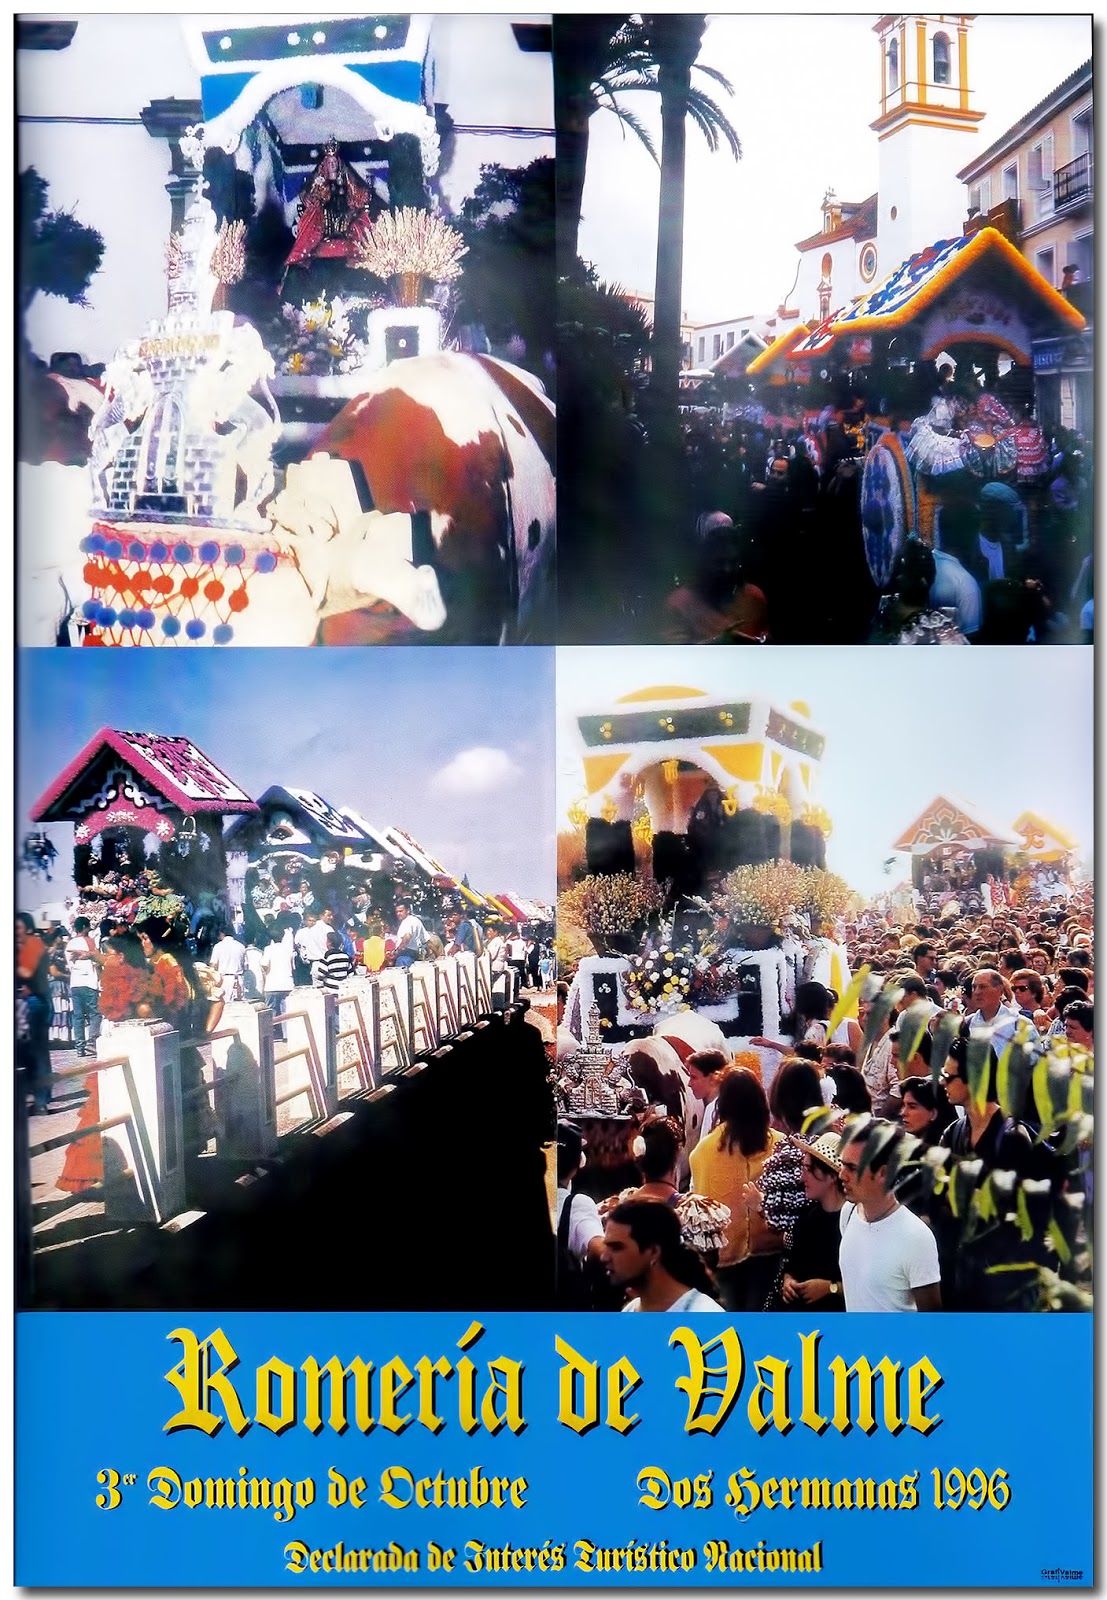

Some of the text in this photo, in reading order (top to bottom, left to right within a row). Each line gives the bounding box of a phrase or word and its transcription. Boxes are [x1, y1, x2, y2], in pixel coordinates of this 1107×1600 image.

[163, 1321, 944, 1437] Romería de Valme
[147, 1466, 316, 1523] Domingo
[328, 1466, 367, 1510] de
[378, 1466, 529, 1510] Octubre
[636, 1466, 1011, 1522] Dos Hermanas 1996
[284, 1539, 823, 1573] Declarada de Interés Turístico Nacional
